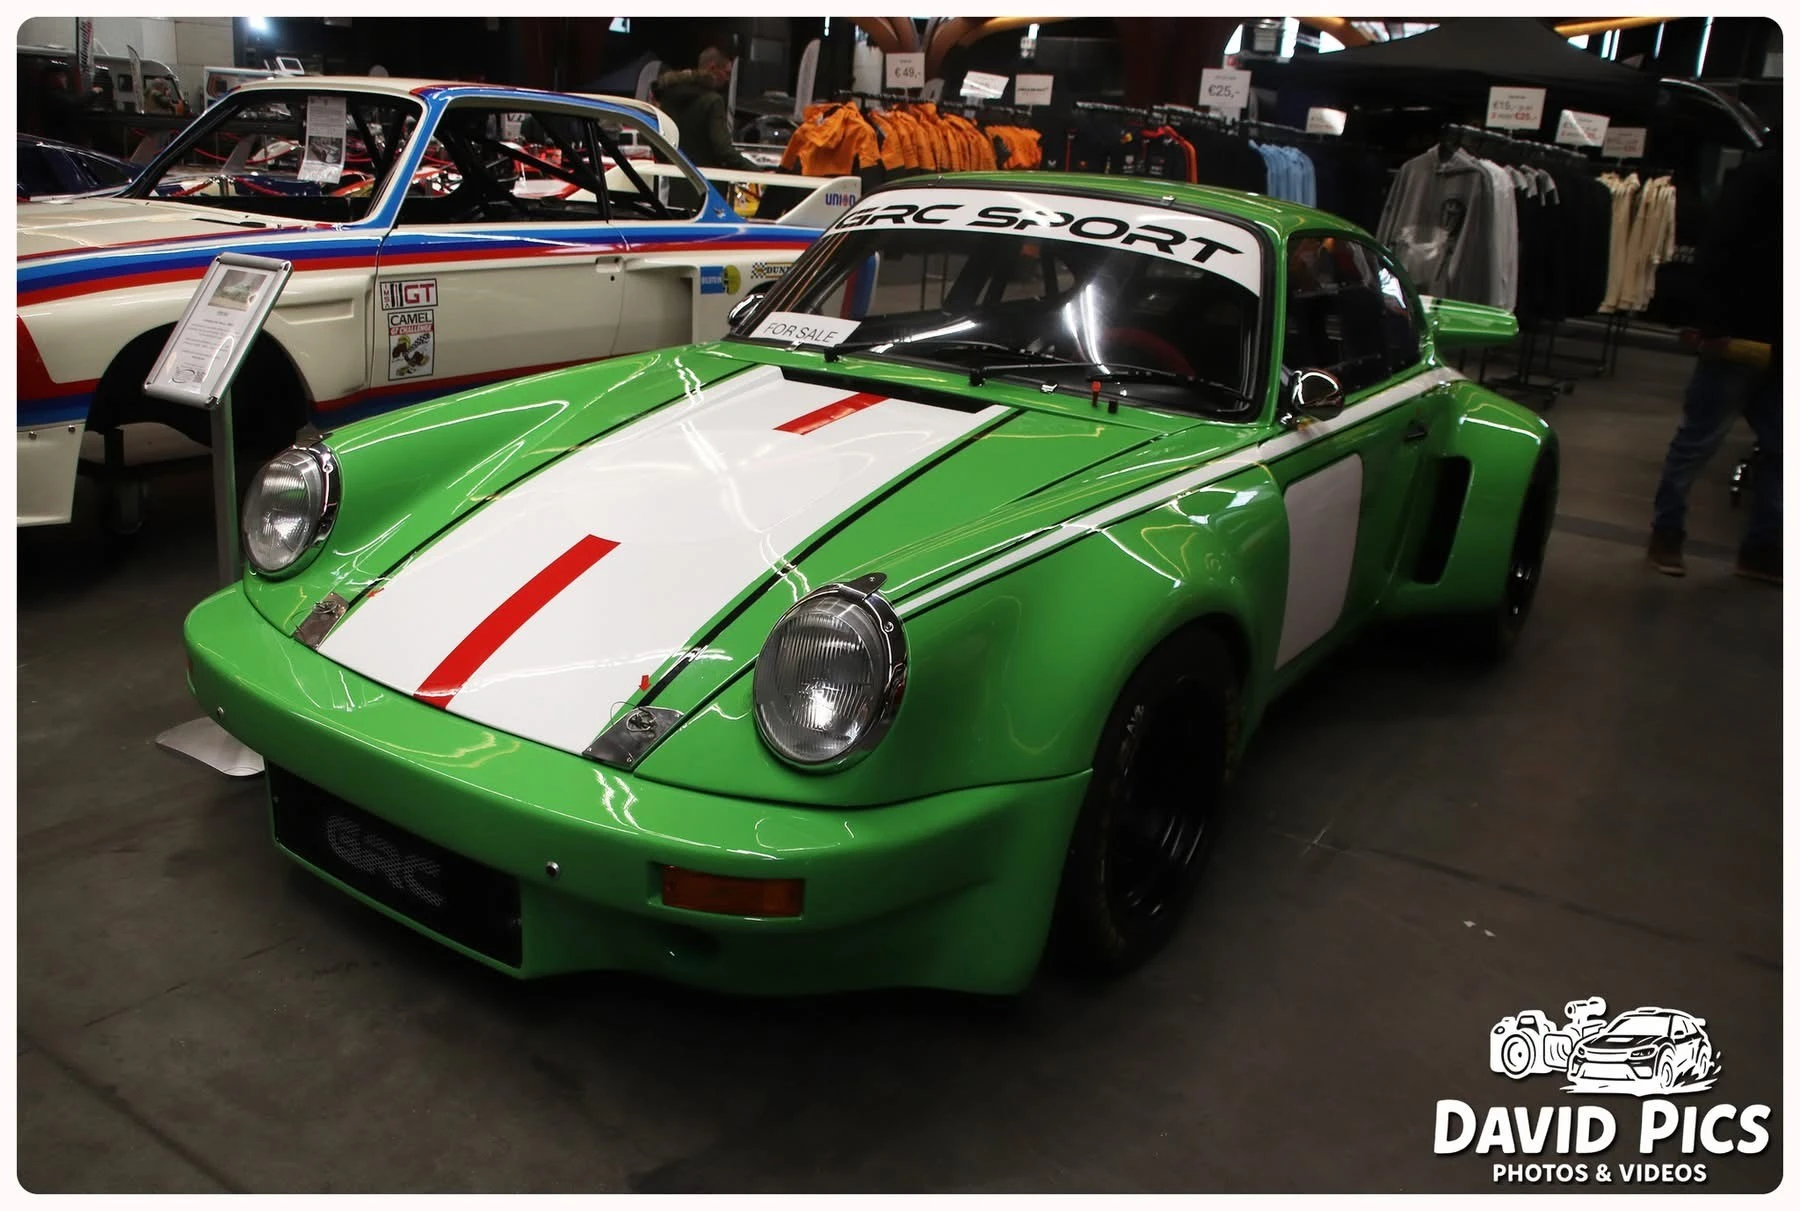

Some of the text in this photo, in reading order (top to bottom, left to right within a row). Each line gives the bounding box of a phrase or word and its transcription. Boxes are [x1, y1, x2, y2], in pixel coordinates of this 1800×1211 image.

[1208, 84, 1240, 98] €25,-
[825, 193, 856, 207] UNION
[834, 204, 1244, 264] GRC SPORT
[404, 284, 434, 304] GT
[390, 313, 432, 325] CAMEL
[764, 322, 838, 343] FOR SALE
[327, 815, 443, 907] GRC
